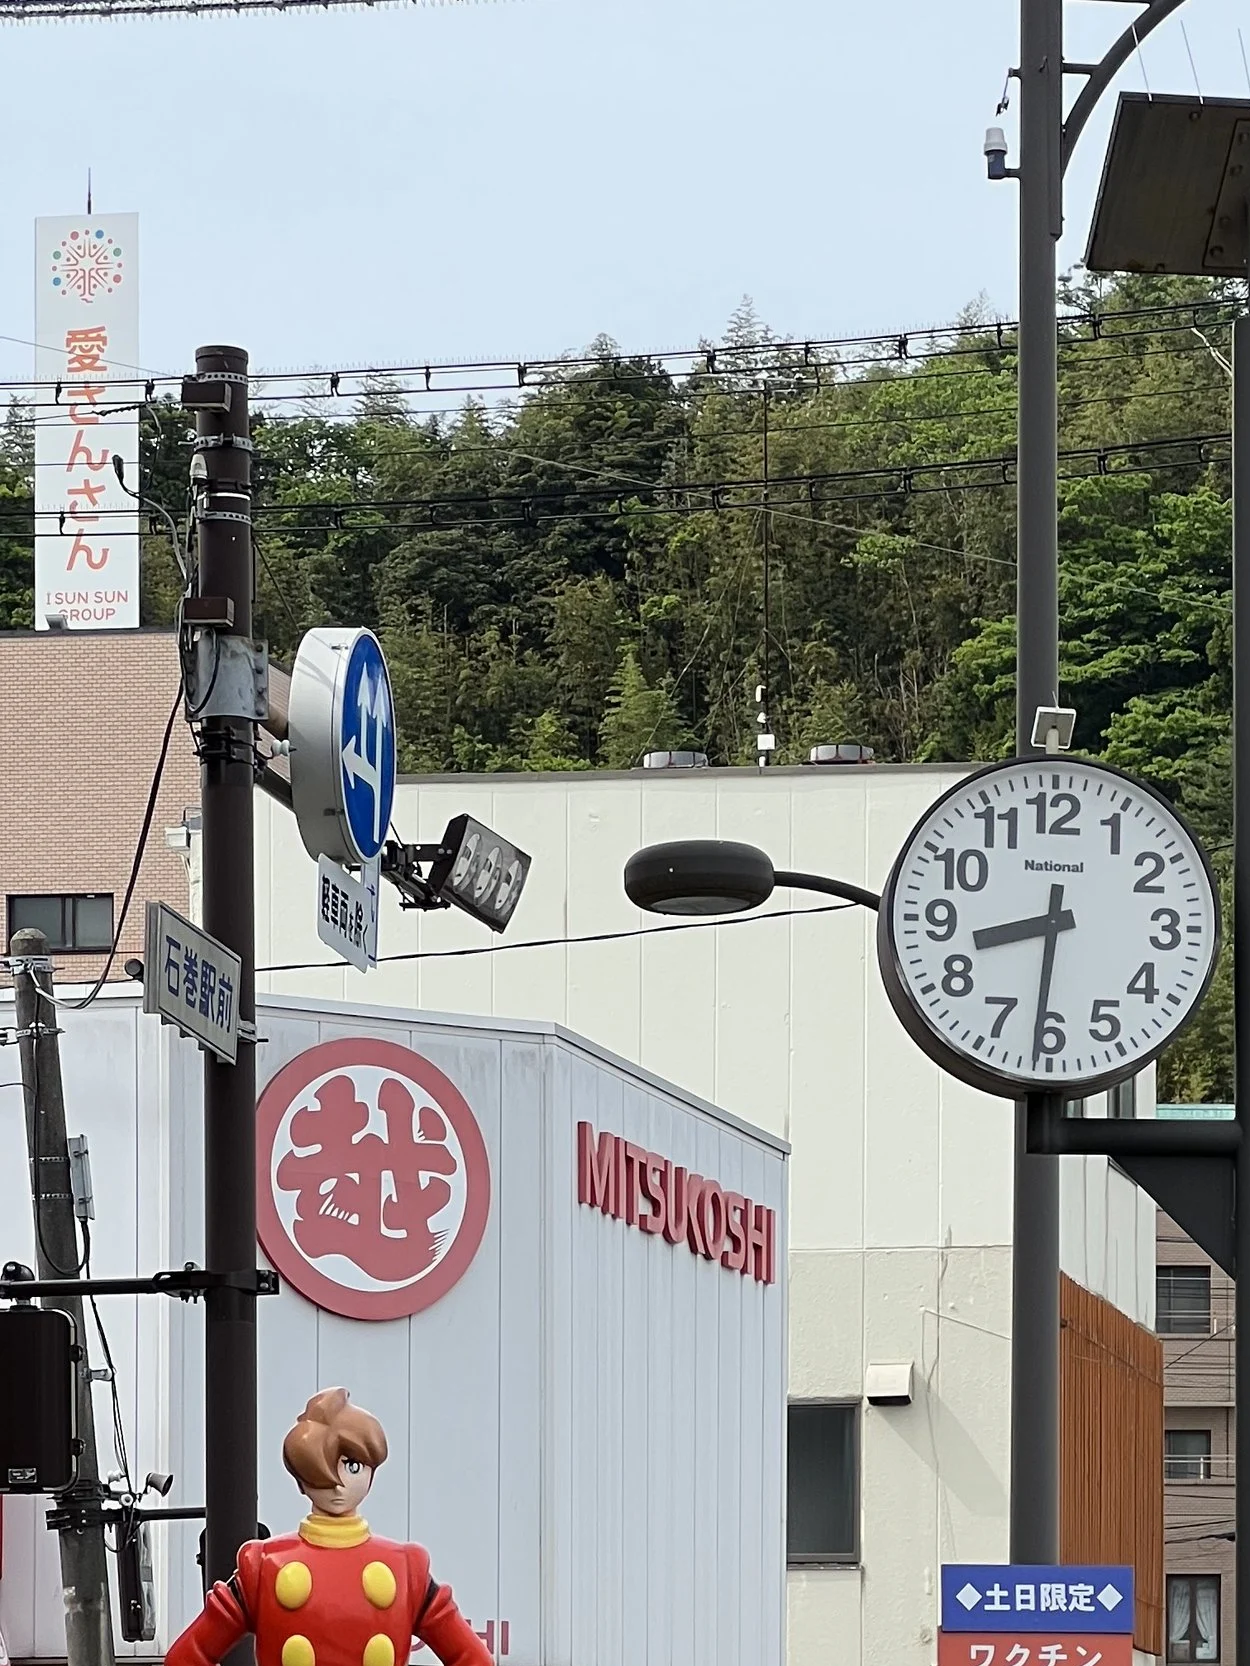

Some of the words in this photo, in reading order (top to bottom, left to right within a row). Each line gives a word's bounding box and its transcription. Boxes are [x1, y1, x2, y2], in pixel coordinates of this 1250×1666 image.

[66, 325, 110, 571] 愛さんさん
[55, 591, 89, 605] SUN
[94, 589, 129, 603] SUN
[974, 805, 1018, 849] 11
[1026, 791, 1081, 835] 12
[1100, 812, 1121, 855] 1
[934, 848, 989, 892] 10
[1024, 859, 1084, 873] National
[1133, 852, 1165, 893] 2
[925, 898, 957, 941] 9
[1149, 908, 1181, 950] 3
[164, 934, 235, 1034] 石巻駅前
[941, 954, 974, 997] 8
[1126, 962, 1159, 1004] 4
[985, 996, 1018, 1038] 7
[1040, 1011, 1066, 1055] 6
[1089, 999, 1121, 1042] 5
[577, 1120, 776, 1284] MITSUKOSHI
[983, 1583, 1096, 1612] 土日限定
